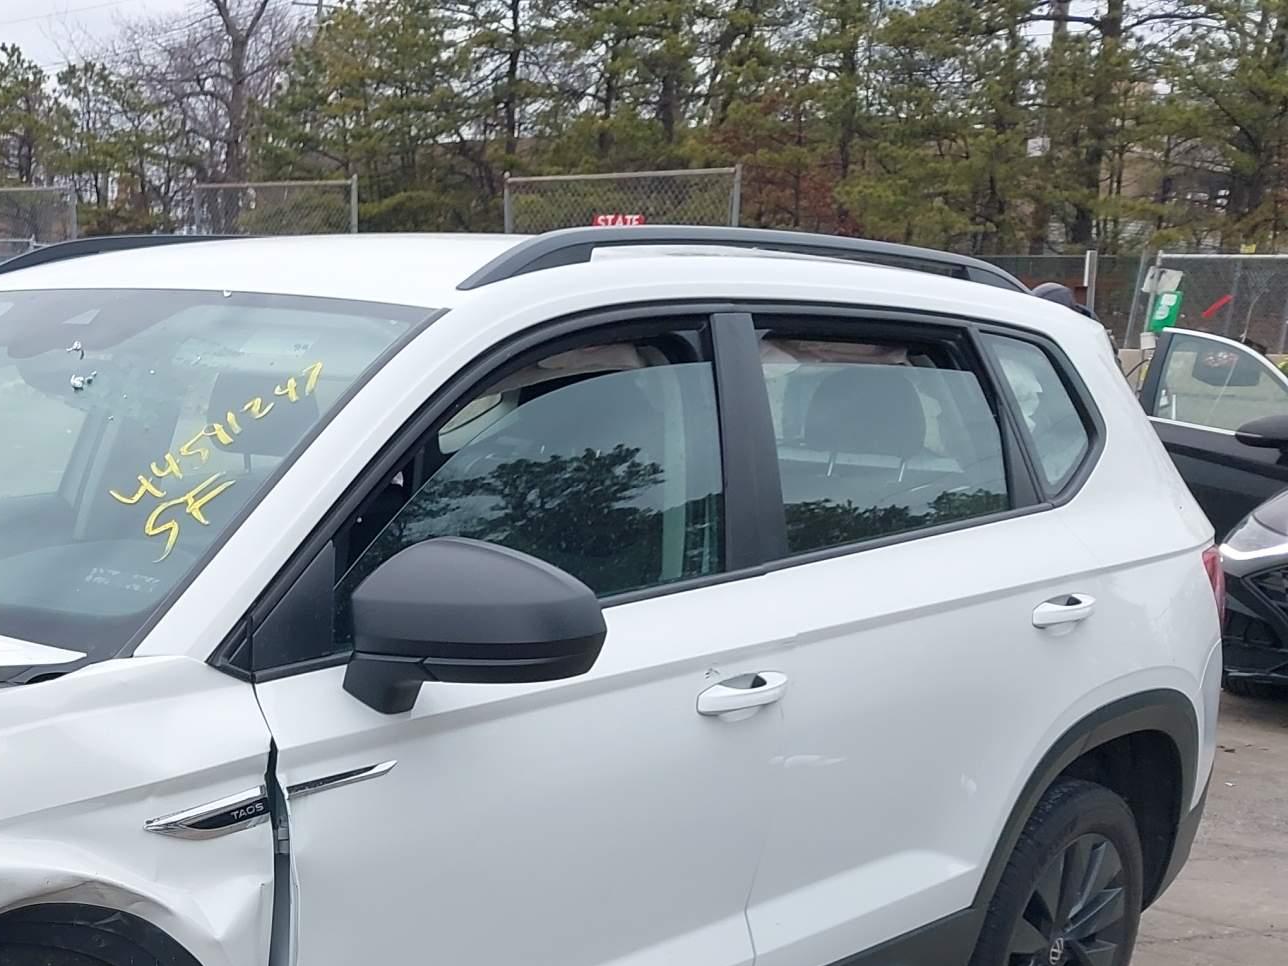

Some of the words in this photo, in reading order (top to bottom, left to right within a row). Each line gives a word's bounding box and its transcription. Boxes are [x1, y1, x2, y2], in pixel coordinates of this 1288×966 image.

[596, 214, 641, 226] STATE
[109, 361, 323, 504] 44591247
[144, 470, 237, 563] SF
[230, 802, 264, 820] TAOS
